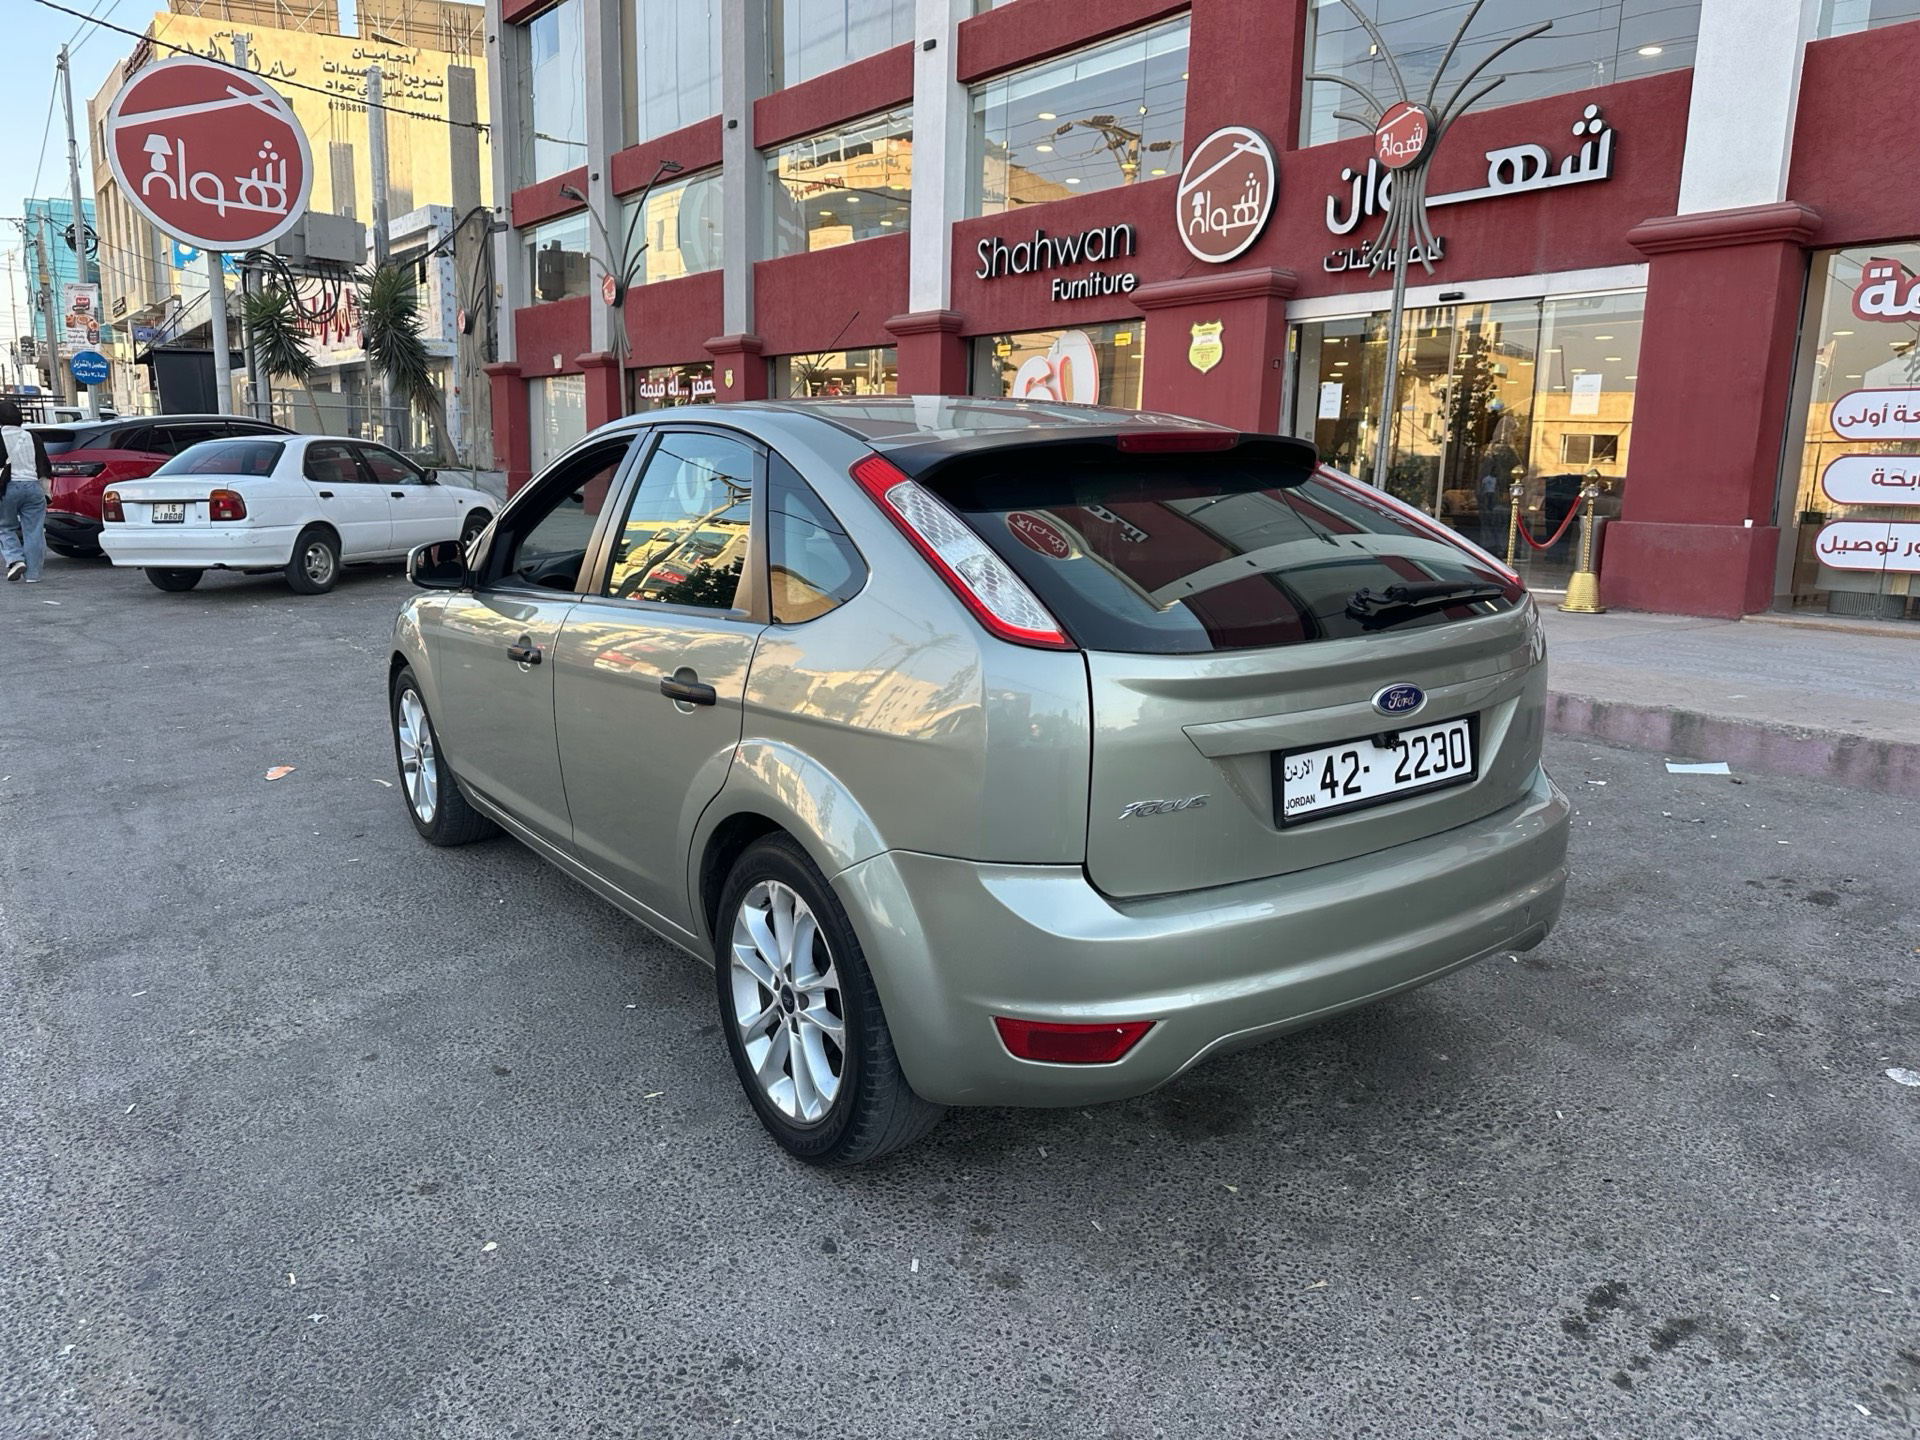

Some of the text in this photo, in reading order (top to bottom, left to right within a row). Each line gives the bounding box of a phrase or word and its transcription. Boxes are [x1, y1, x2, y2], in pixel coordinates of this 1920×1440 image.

[352, 48, 416, 66] المحاميان
[1380, 122, 1423, 158] شهوان
[143, 133, 288, 218] شهوان
[1189, 172, 1261, 237] شهوان
[976, 223, 1136, 280] Shahwan
[1051, 271, 1136, 301] Furniture
[1837, 402, 1889, 428] أولى
[1820, 535, 1899, 556] توصيل
[1388, 689, 1416, 710] Ford
[1394, 727, 1467, 784] 2230
[1285, 793, 1316, 810] JORDAN
